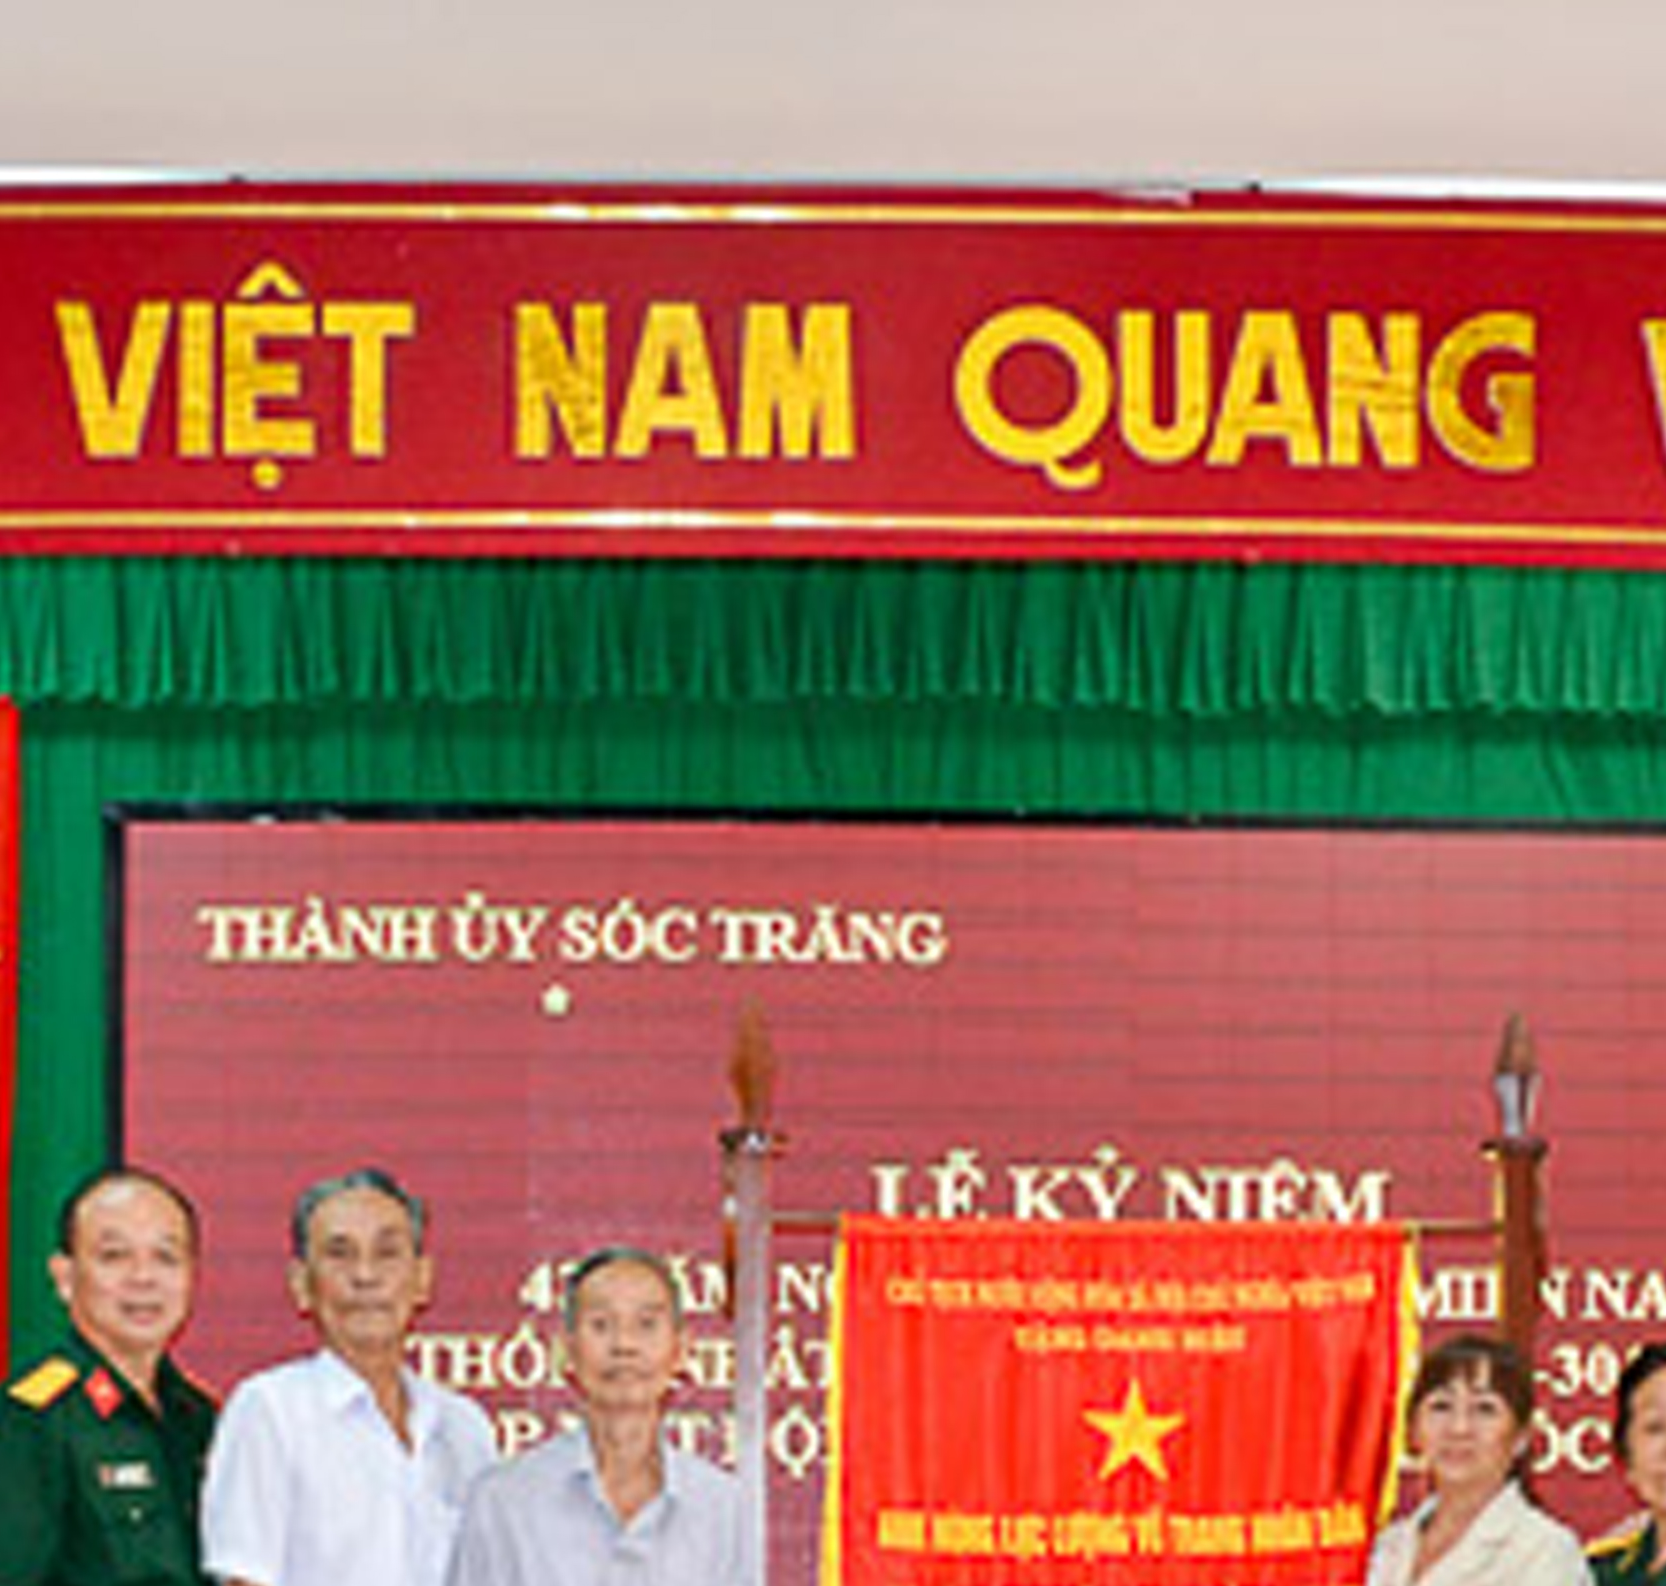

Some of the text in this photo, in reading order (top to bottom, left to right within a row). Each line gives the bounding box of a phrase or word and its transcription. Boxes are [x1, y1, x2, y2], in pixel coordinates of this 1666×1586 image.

[54, 262, 414, 488] VIỆT
[513, 303, 854, 460] NAM
[953, 304, 1534, 490] QUANG
[199, 890, 949, 964] THÀNH ỦY SÓC TRĂNG
